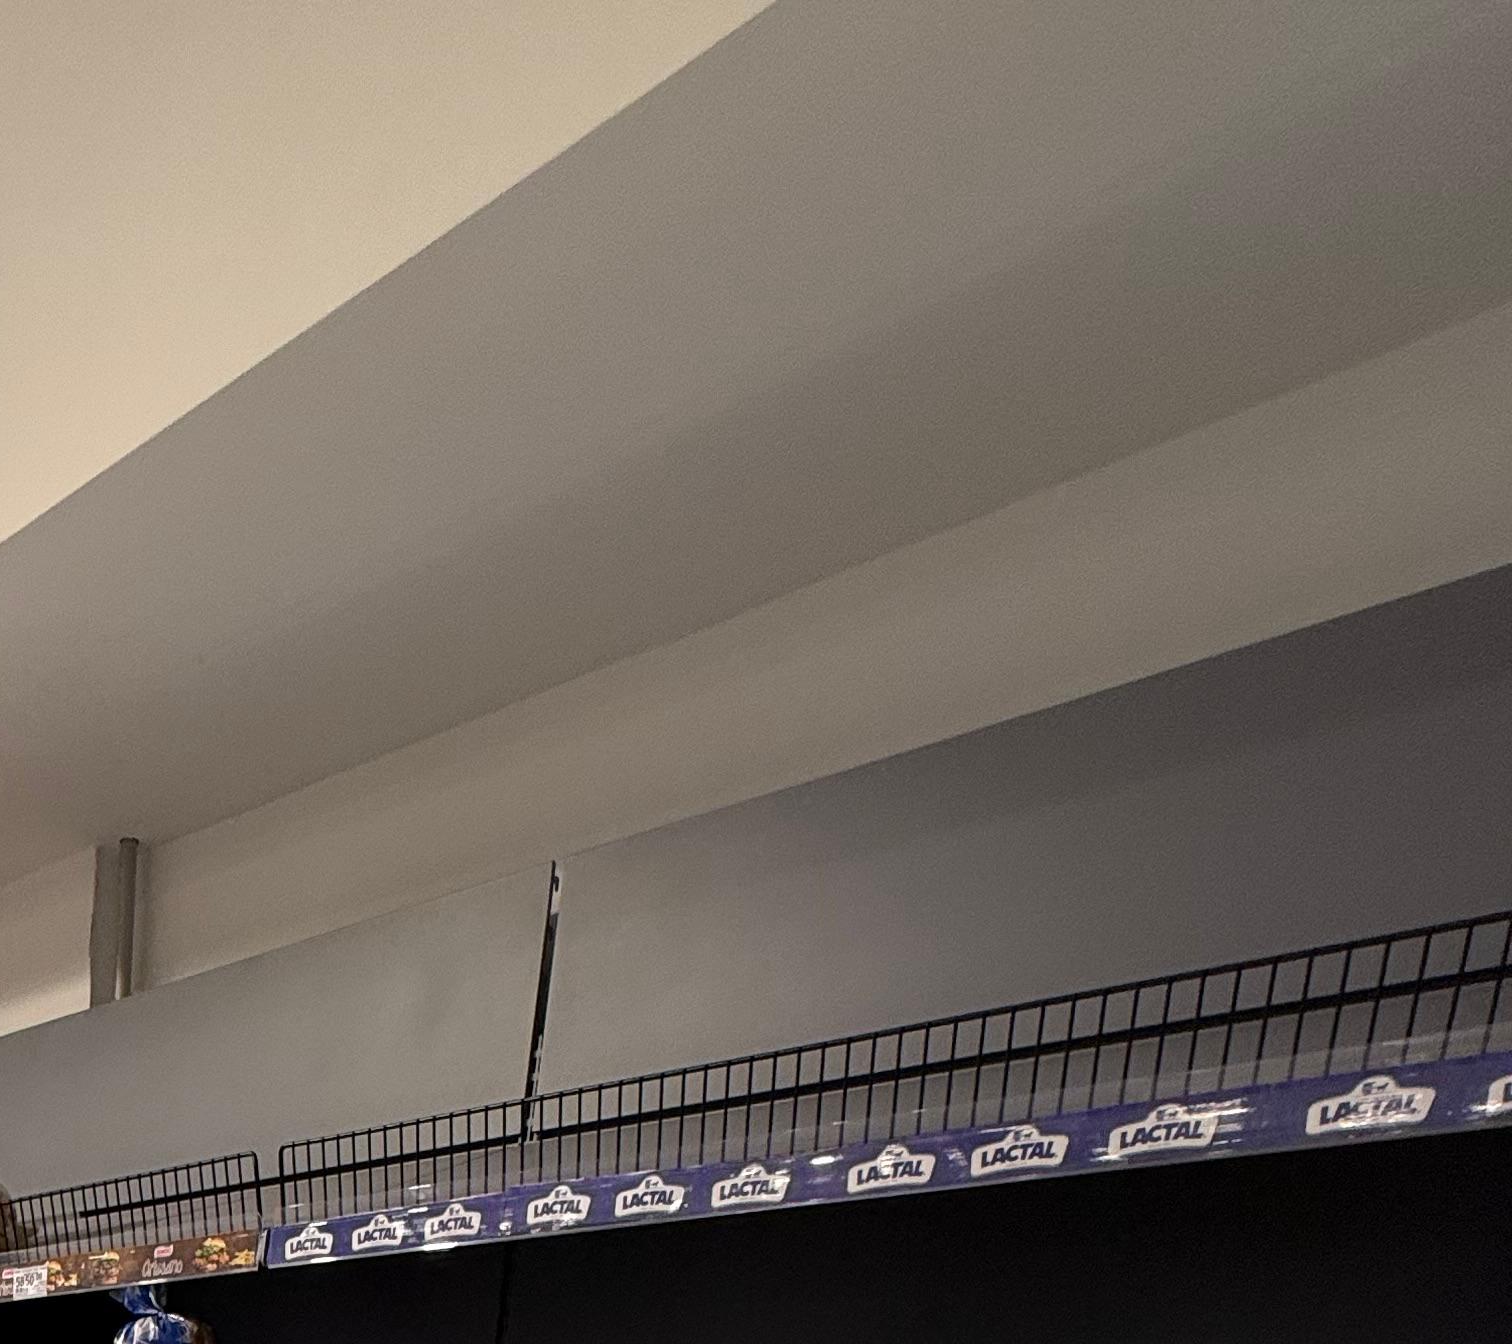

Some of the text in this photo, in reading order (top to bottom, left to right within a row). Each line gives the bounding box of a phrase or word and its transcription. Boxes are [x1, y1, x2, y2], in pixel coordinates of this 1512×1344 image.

[1319, 1093, 1416, 1126] LACTAL
[1118, 1120, 1205, 1150] LACTAL
[980, 1141, 1056, 1168] LACTAL
[856, 1159, 924, 1187] LACTAL
[621, 1188, 675, 1211] LACTAL
[719, 1178, 780, 1200] LACTAL
[533, 1197, 583, 1218] LACTAL
[357, 1224, 398, 1245] LACTAL
[430, 1214, 475, 1235] LACTAL
[290, 1236, 328, 1254] LACTAL
